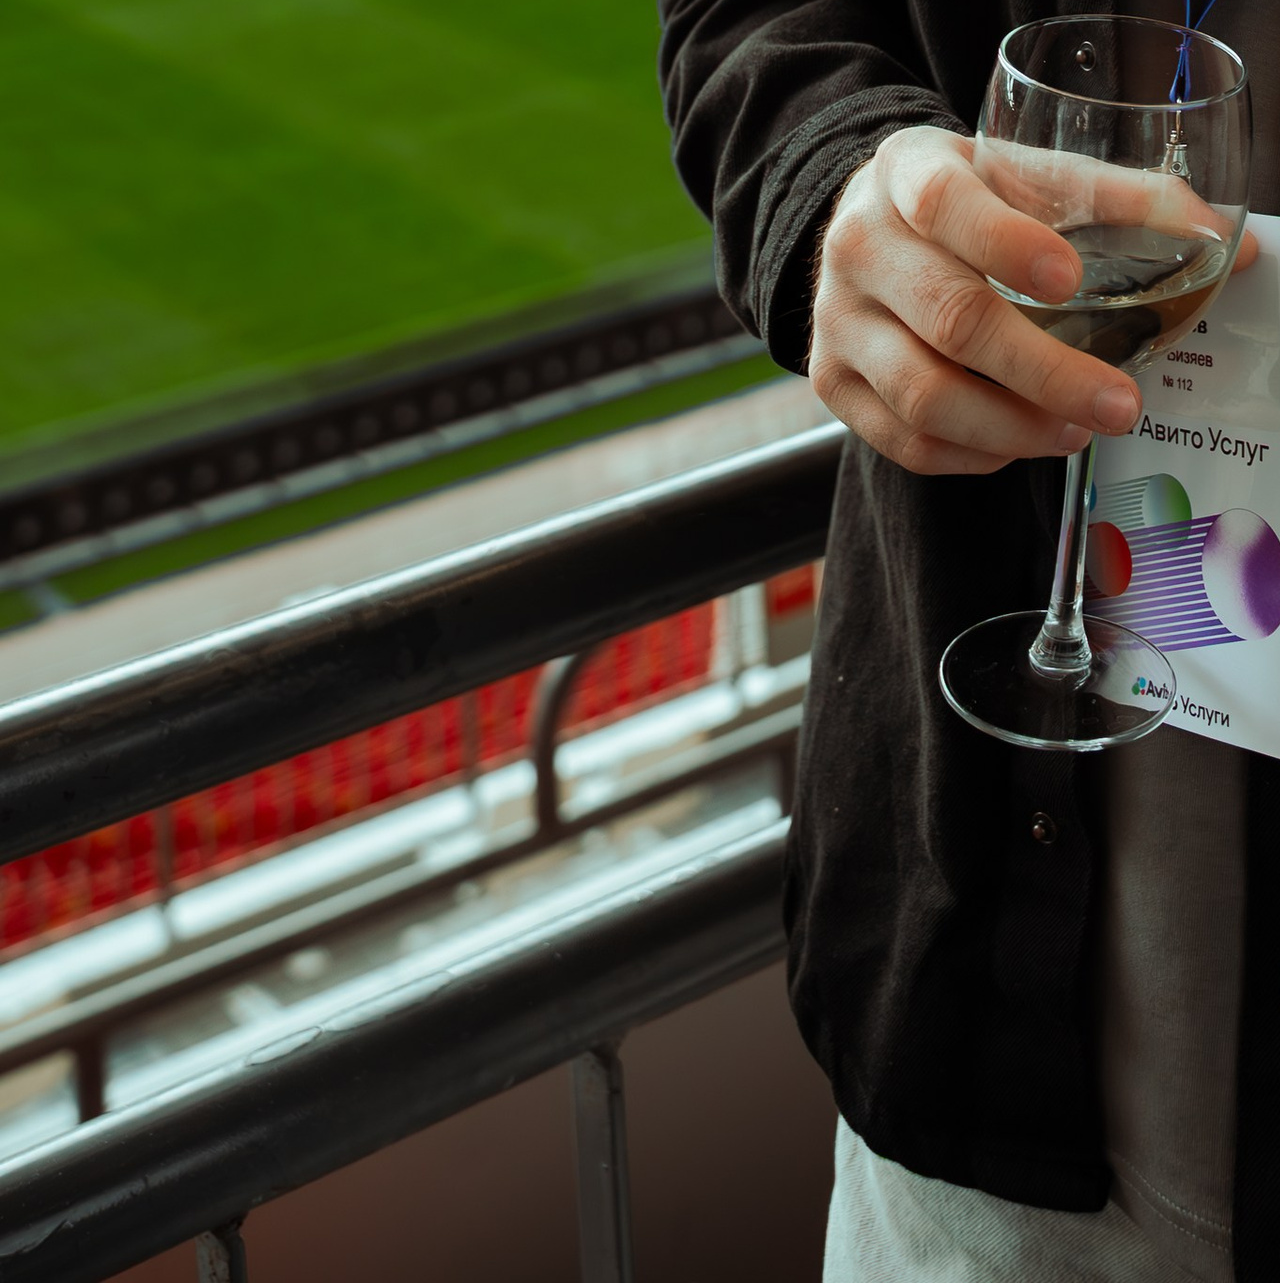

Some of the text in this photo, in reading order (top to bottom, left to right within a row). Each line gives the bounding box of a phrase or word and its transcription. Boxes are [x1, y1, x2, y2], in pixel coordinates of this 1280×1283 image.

[1177, 377, 1193, 391] 112
[1139, 414, 1270, 466] Авито Услуг
[1180, 695, 1230, 727] Услуги
